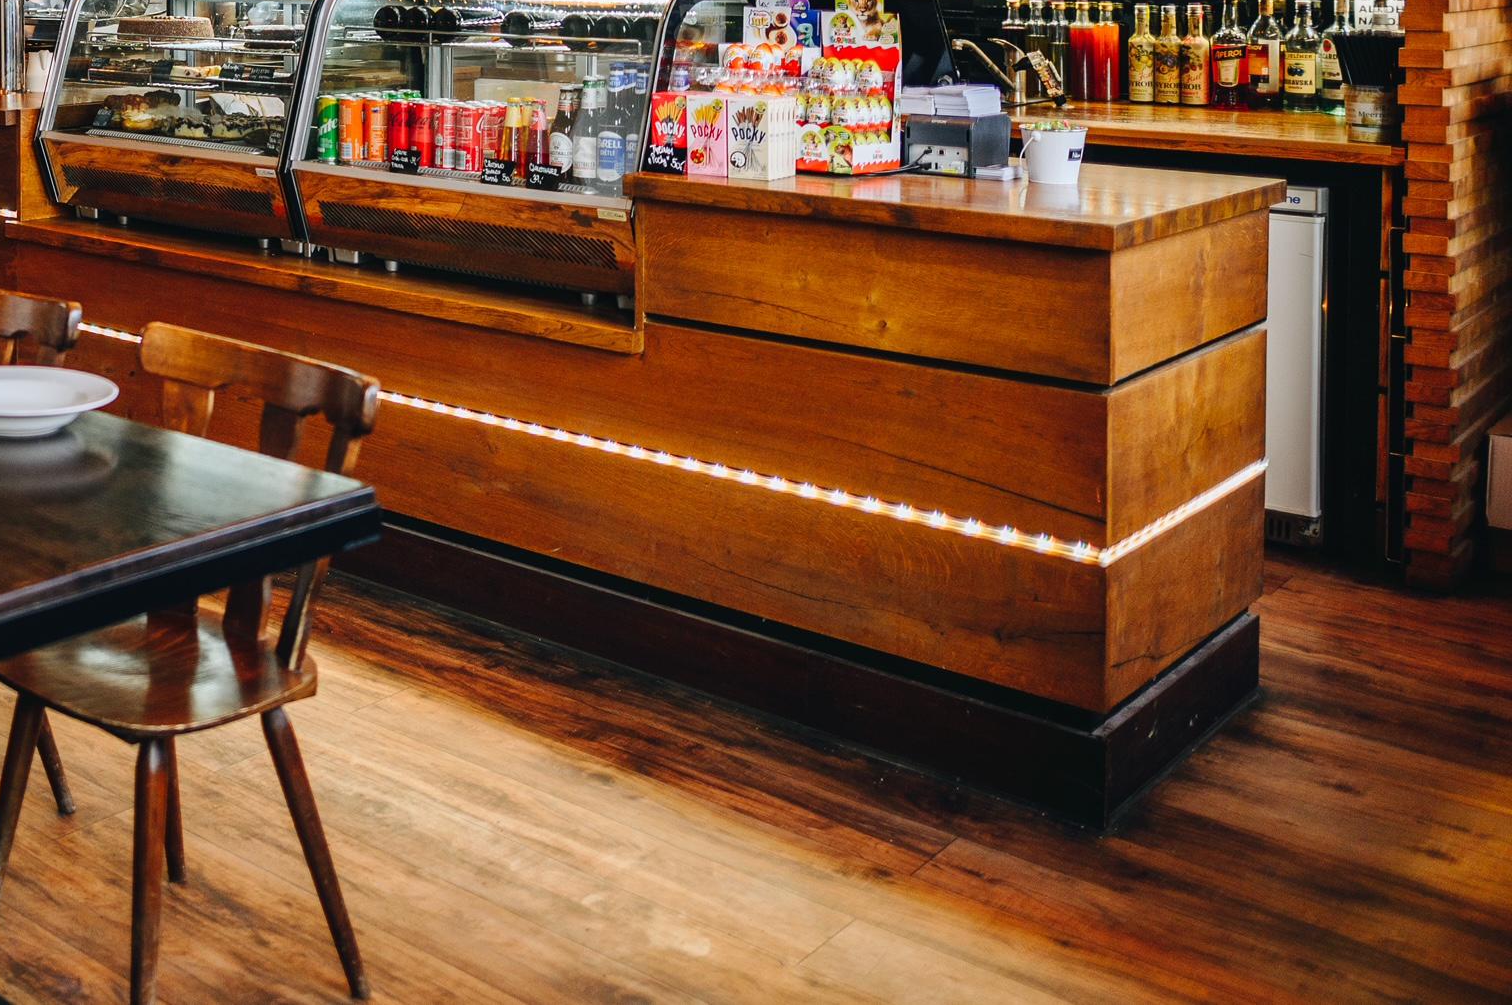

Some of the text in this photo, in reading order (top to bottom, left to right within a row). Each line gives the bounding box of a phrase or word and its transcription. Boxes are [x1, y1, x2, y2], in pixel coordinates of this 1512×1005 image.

[655, 121, 686, 139] POCKY
[690, 124, 723, 141] POCKY
[731, 126, 766, 144] POCKY
